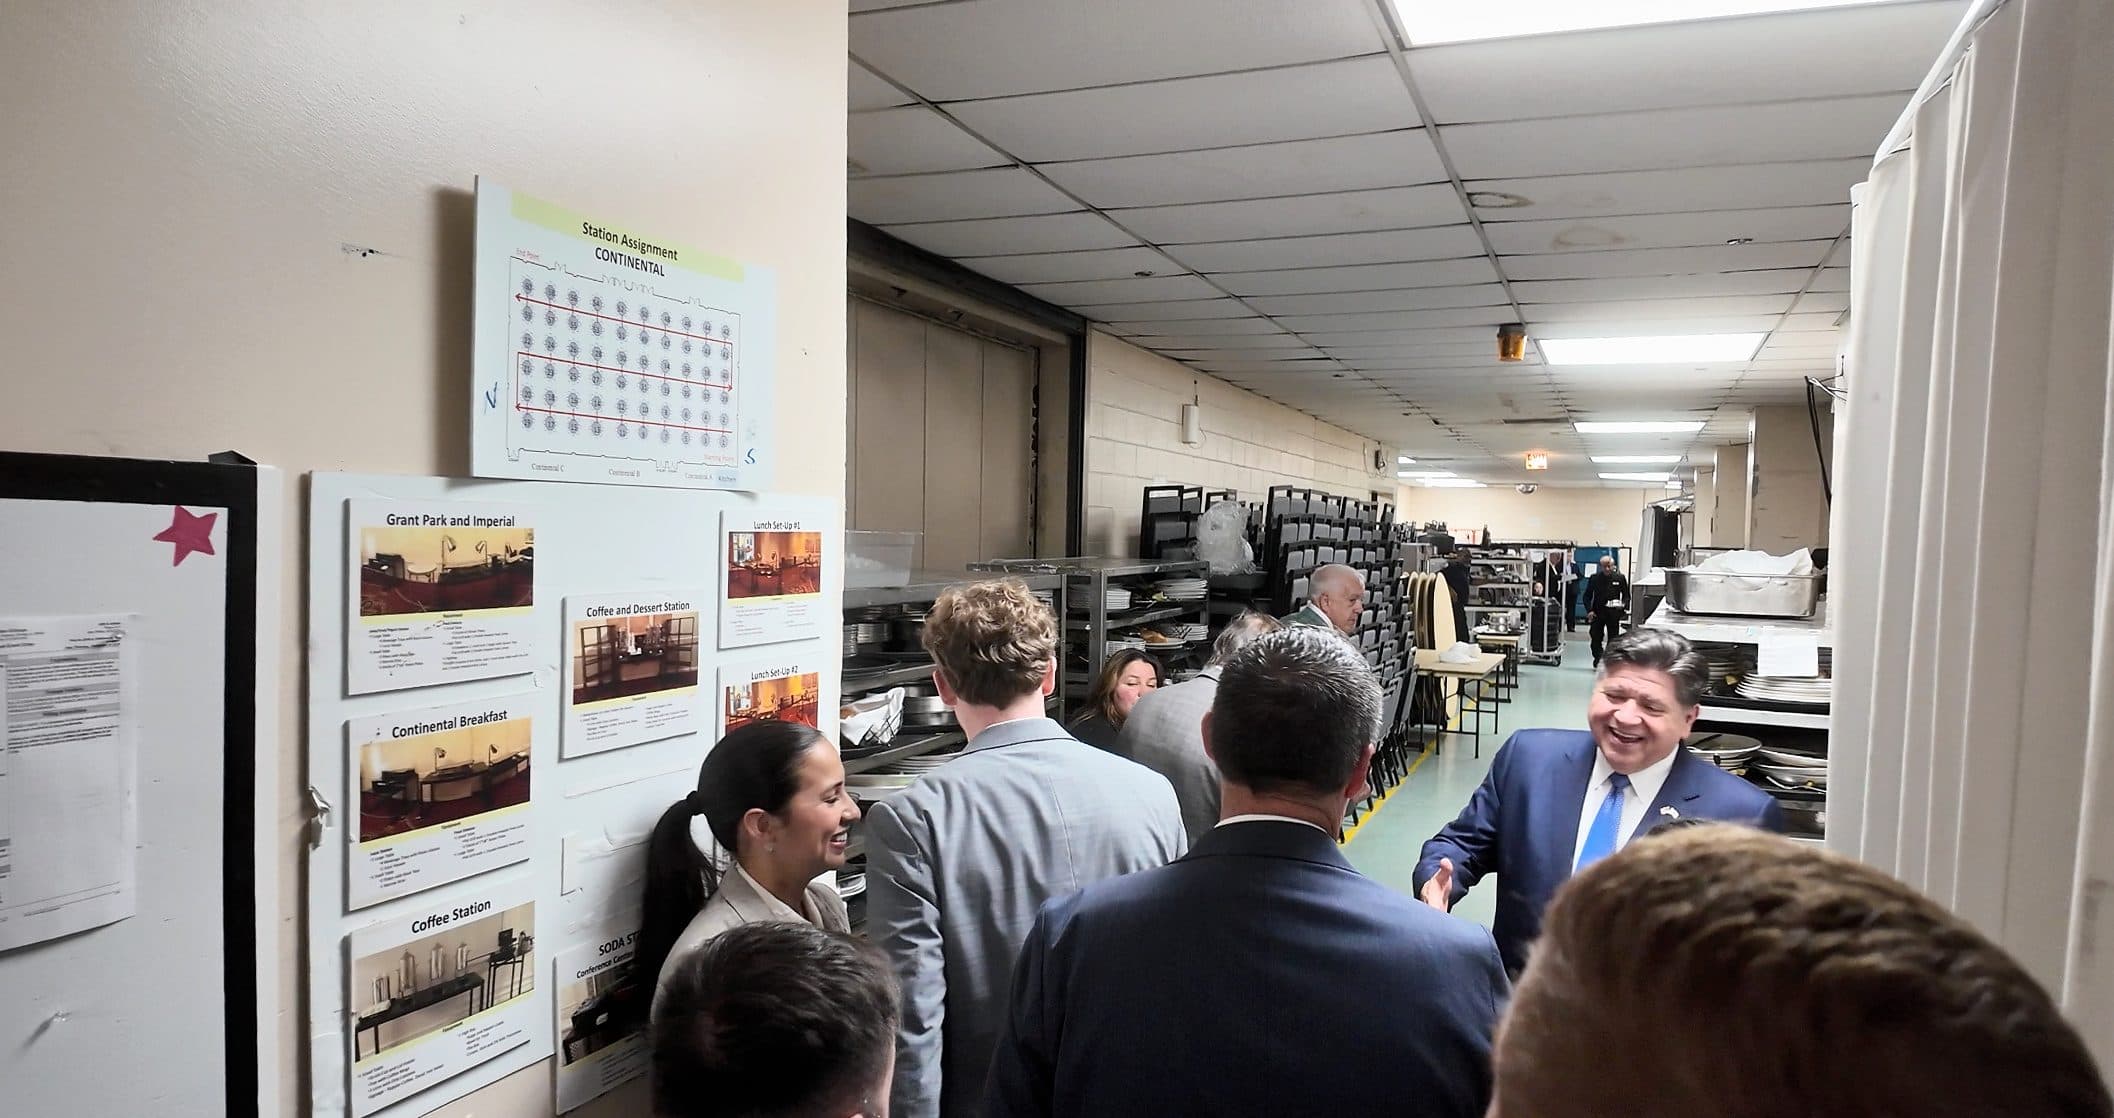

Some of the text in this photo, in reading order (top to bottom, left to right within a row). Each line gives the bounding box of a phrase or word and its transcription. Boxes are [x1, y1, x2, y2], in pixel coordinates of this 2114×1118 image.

[582, 222, 678, 260] Station Assignment
[595, 247, 665, 276] CONTINENTAL
[744, 448, 756, 464] S
[386, 513, 515, 528] Grant Park and Imperial
[753, 520, 801, 530] Lunch Set-Up #1
[586, 601, 690, 617] Coffee and Dessert Station
[751, 665, 798, 680] Lunch Set-Up #2
[392, 710, 508, 738] Continental Breakfast
[411, 901, 491, 933] Coffee Station
[598, 937, 625, 956] SODA
[576, 959, 612, 979] Conference
